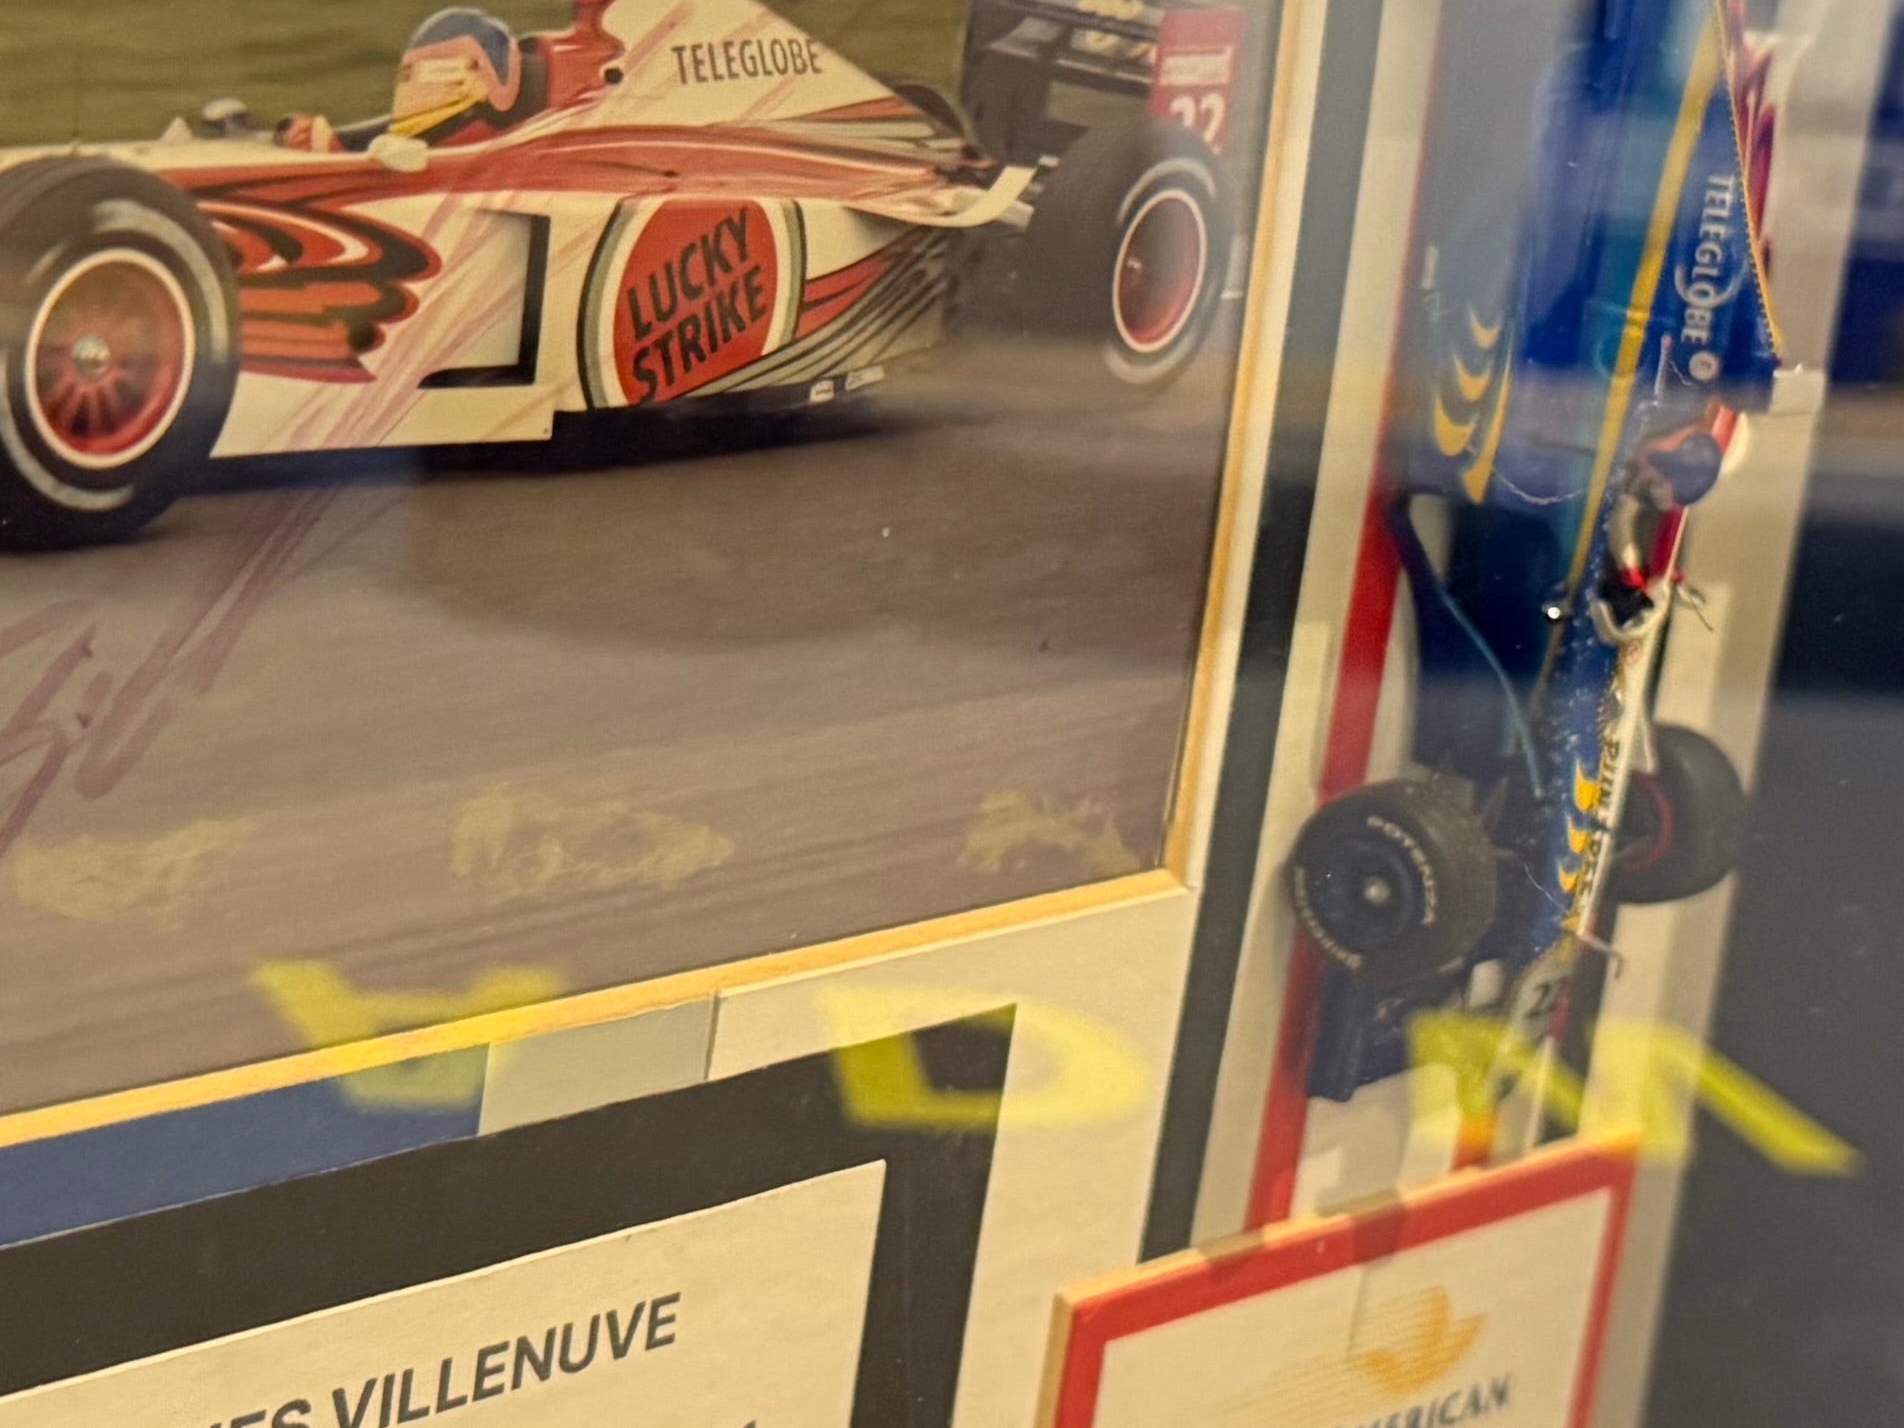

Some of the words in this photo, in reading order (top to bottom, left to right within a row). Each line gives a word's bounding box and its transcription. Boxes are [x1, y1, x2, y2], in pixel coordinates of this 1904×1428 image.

[672, 36, 823, 88] TELEGLOBE
[628, 207, 752, 342] LUCKY
[1680, 174, 1737, 346] TELEGLOBE
[629, 265, 766, 406] STRIKE
